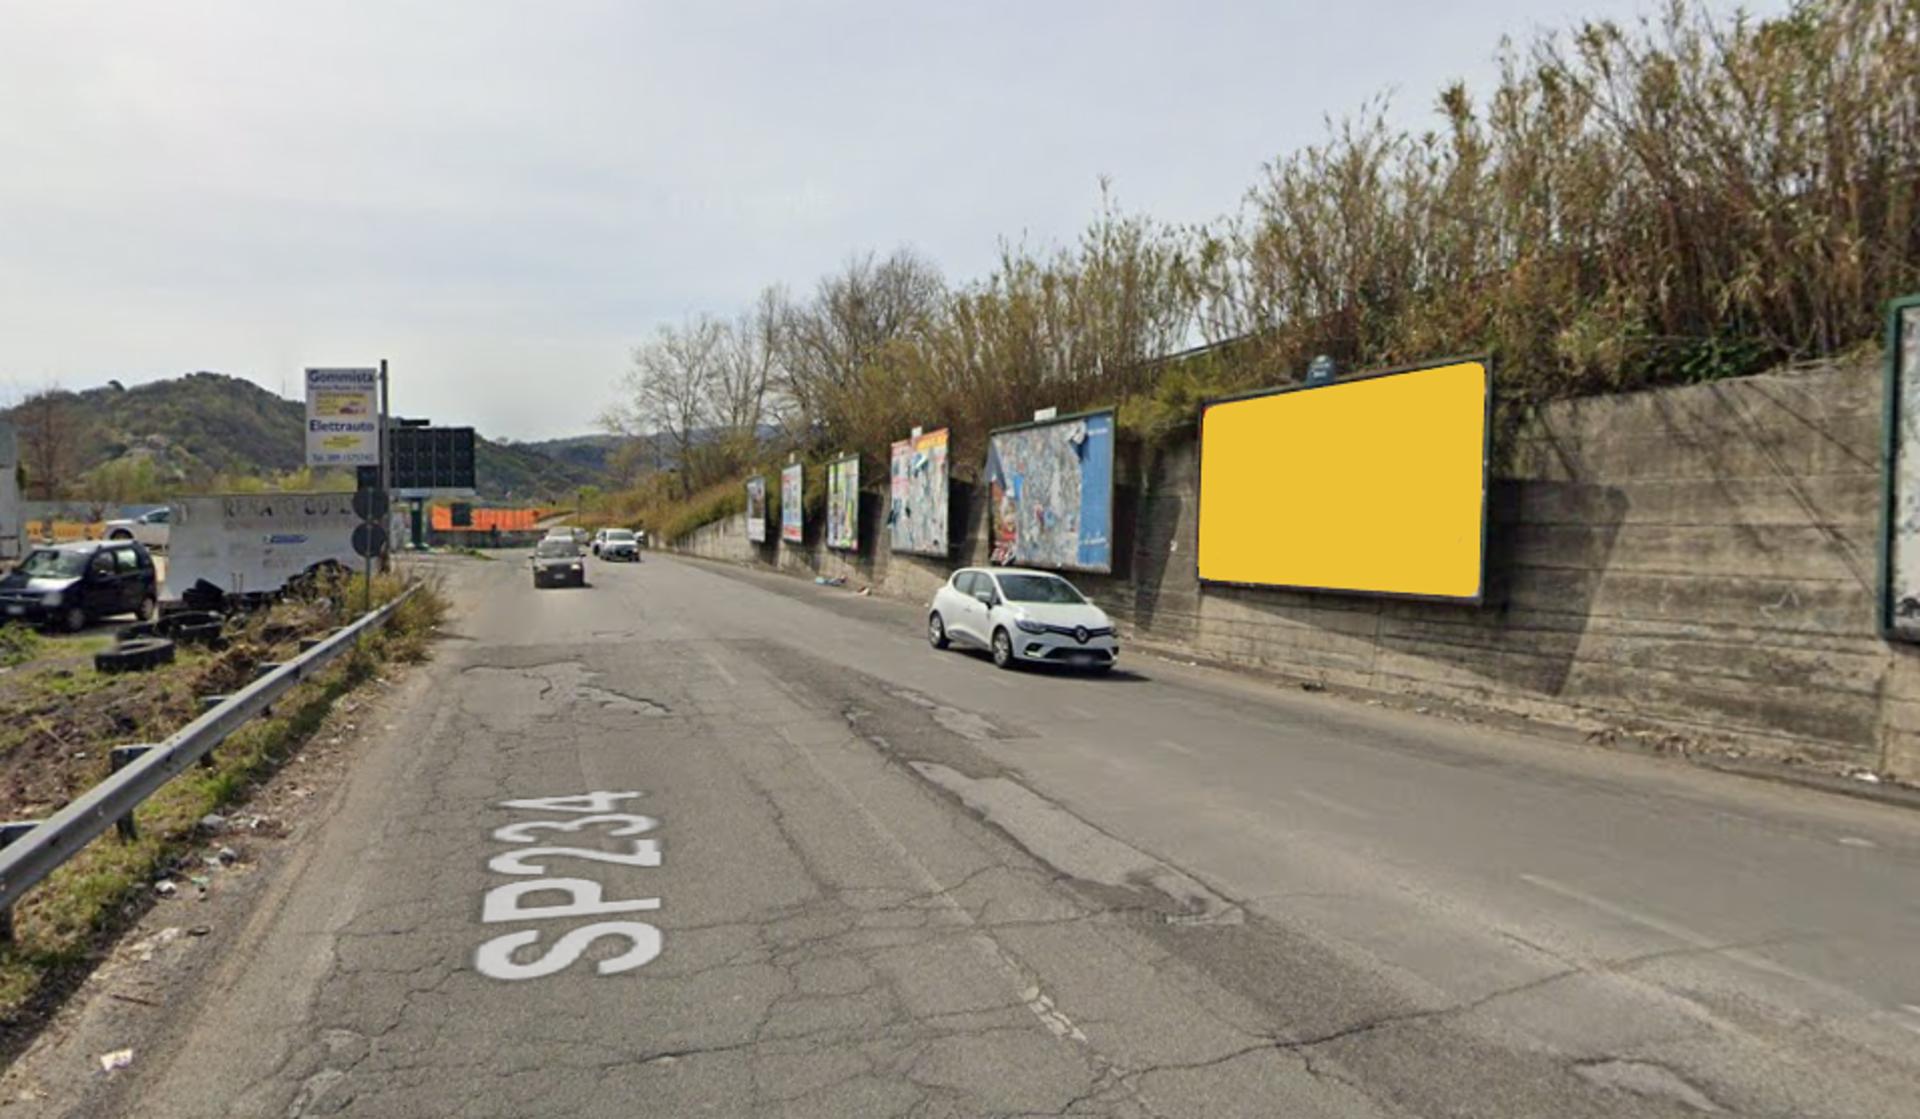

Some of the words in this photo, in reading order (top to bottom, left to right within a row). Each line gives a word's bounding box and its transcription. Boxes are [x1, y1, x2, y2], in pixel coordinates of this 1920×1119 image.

[308, 368, 374, 383] Gommista
[309, 419, 375, 433] Elettrauto
[476, 790, 662, 980] SP234
